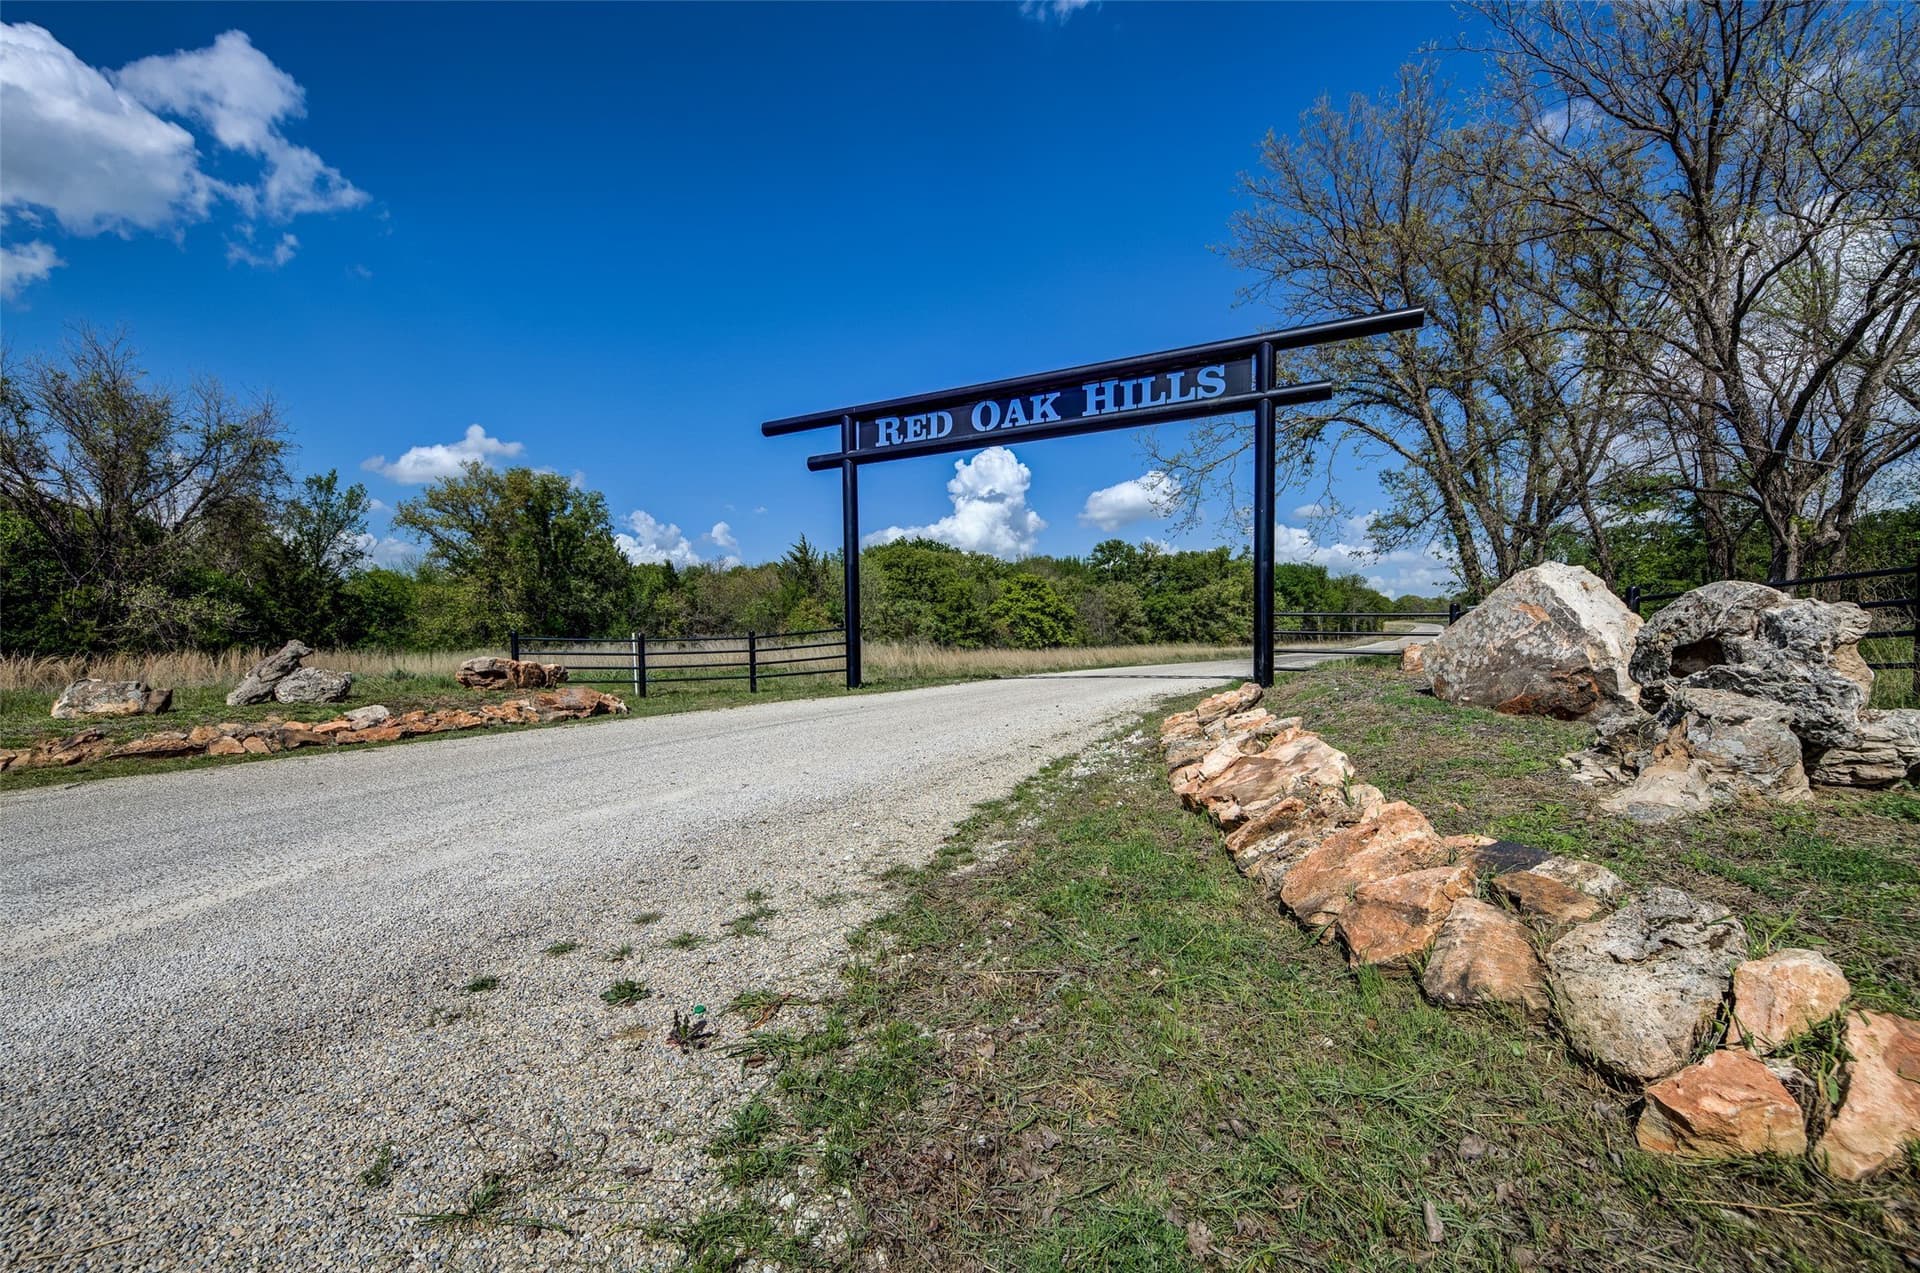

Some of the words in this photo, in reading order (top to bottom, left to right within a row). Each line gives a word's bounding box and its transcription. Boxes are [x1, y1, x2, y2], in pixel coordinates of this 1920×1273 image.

[875, 411, 953, 447] RED
[971, 392, 1061, 431] OAK
[1082, 365, 1226, 416] HILLS
